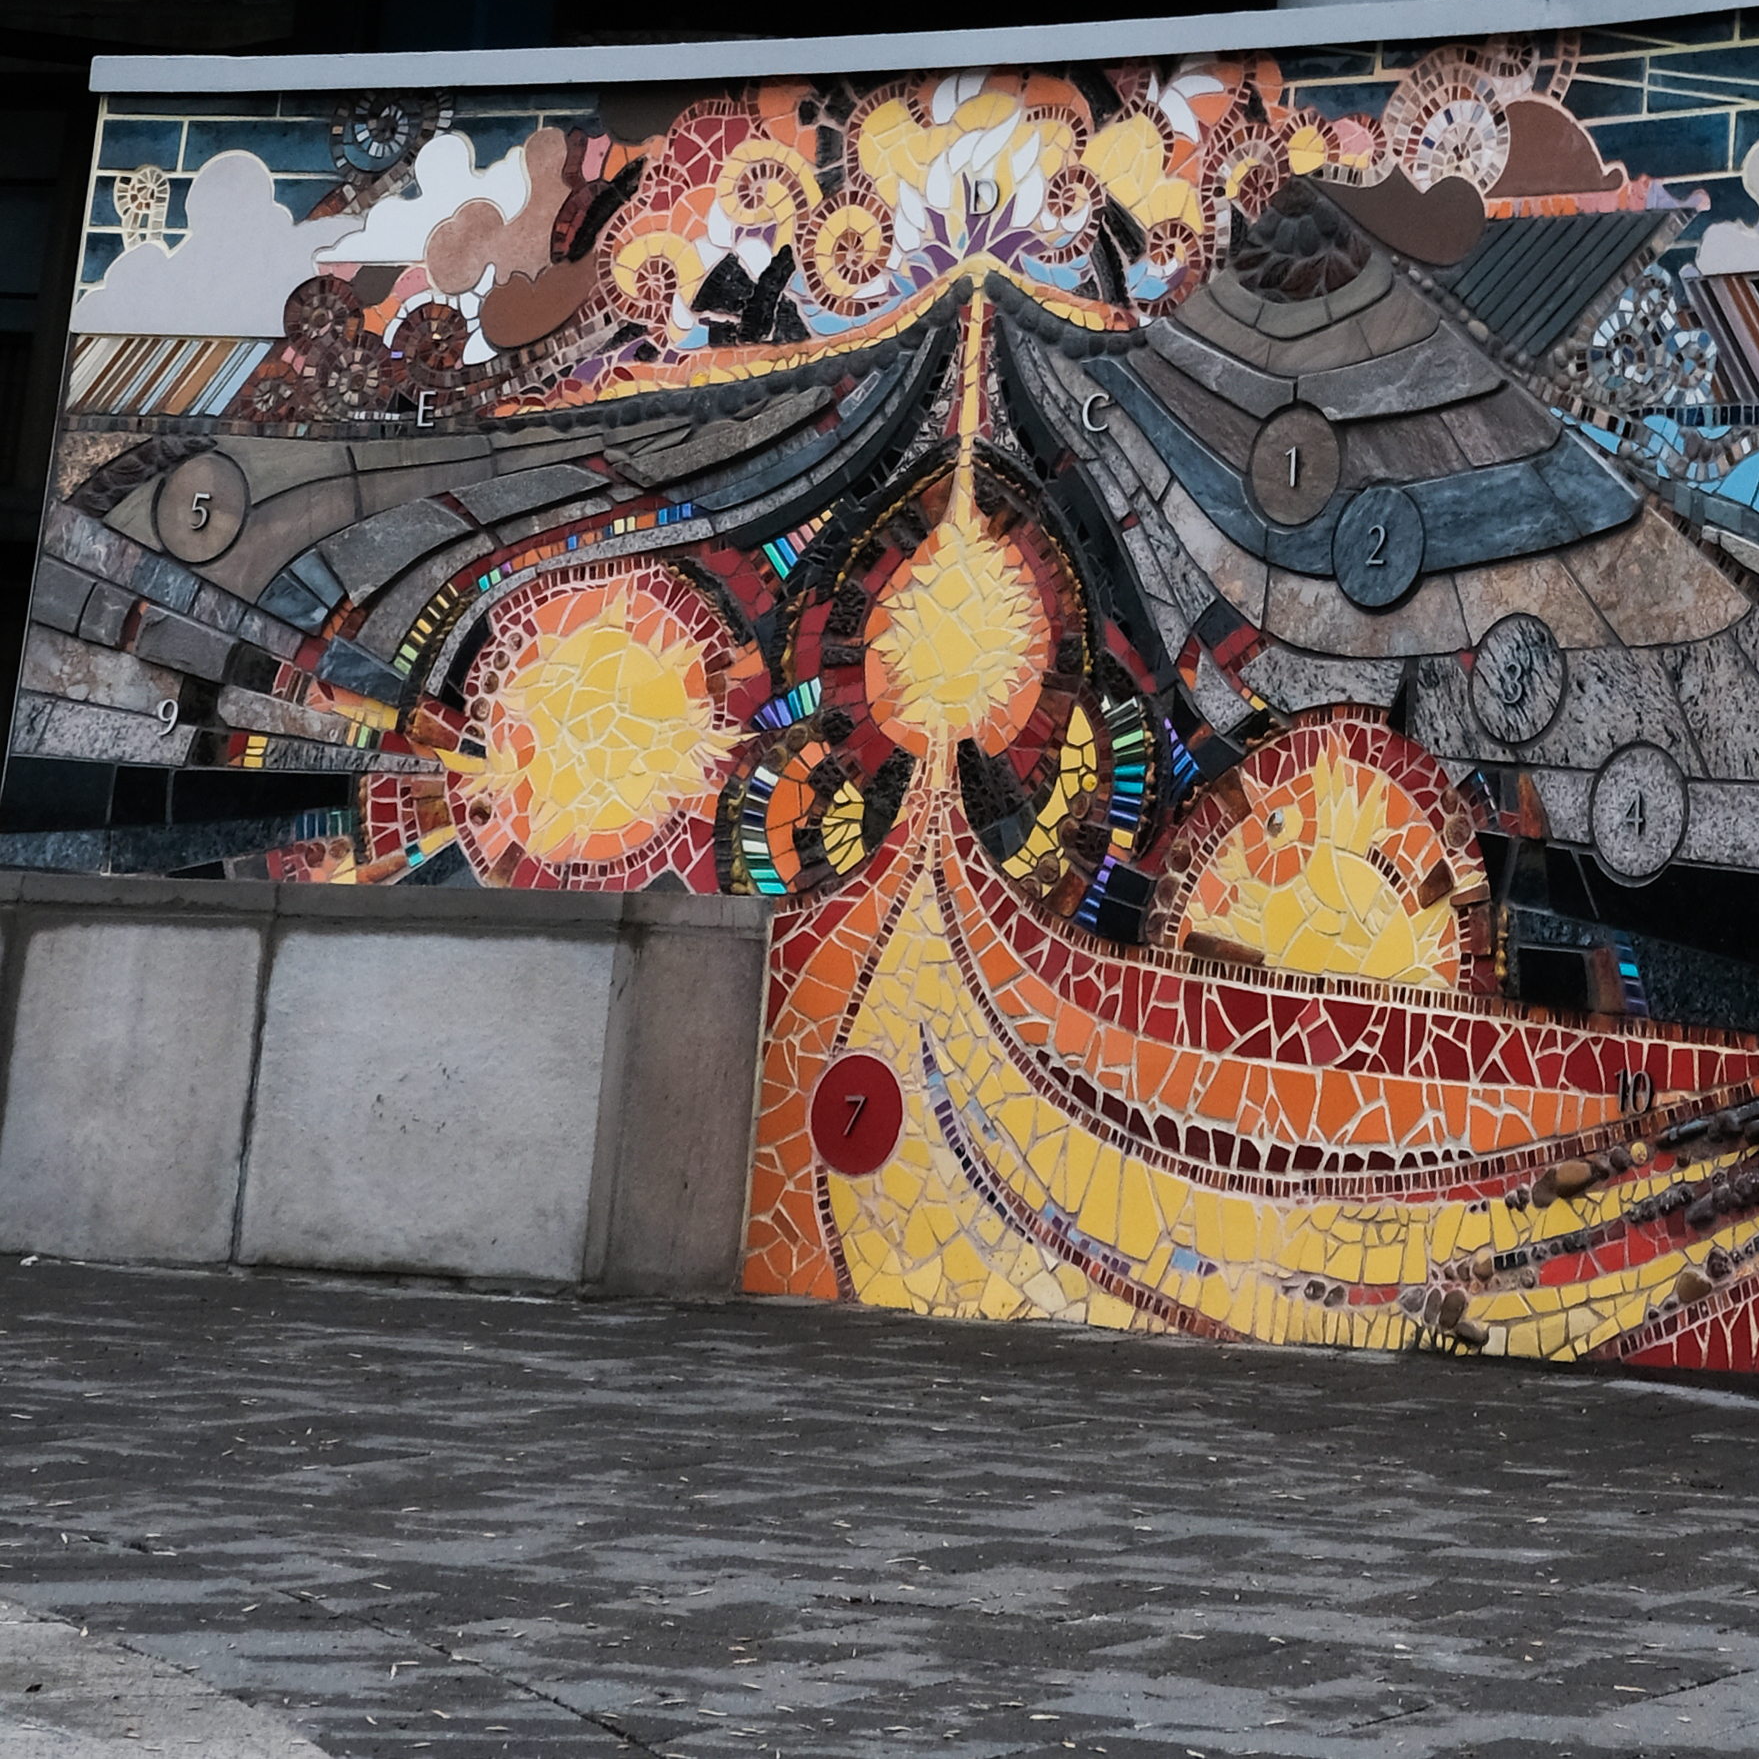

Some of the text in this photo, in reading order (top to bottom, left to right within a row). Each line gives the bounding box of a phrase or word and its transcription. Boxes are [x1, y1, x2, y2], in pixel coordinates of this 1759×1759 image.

[968, 178, 1000, 216] D
[416, 391, 436, 429] E
[1082, 392, 1111, 434] C
[1284, 446, 1298, 488] 1
[190, 493, 211, 531] 5
[1365, 524, 1388, 566] 2
[1503, 664, 1525, 706] 3
[156, 697, 180, 738] 9
[1624, 794, 1645, 834] 4
[1614, 1070, 1653, 1113] 10
[845, 1095, 868, 1137] 7
